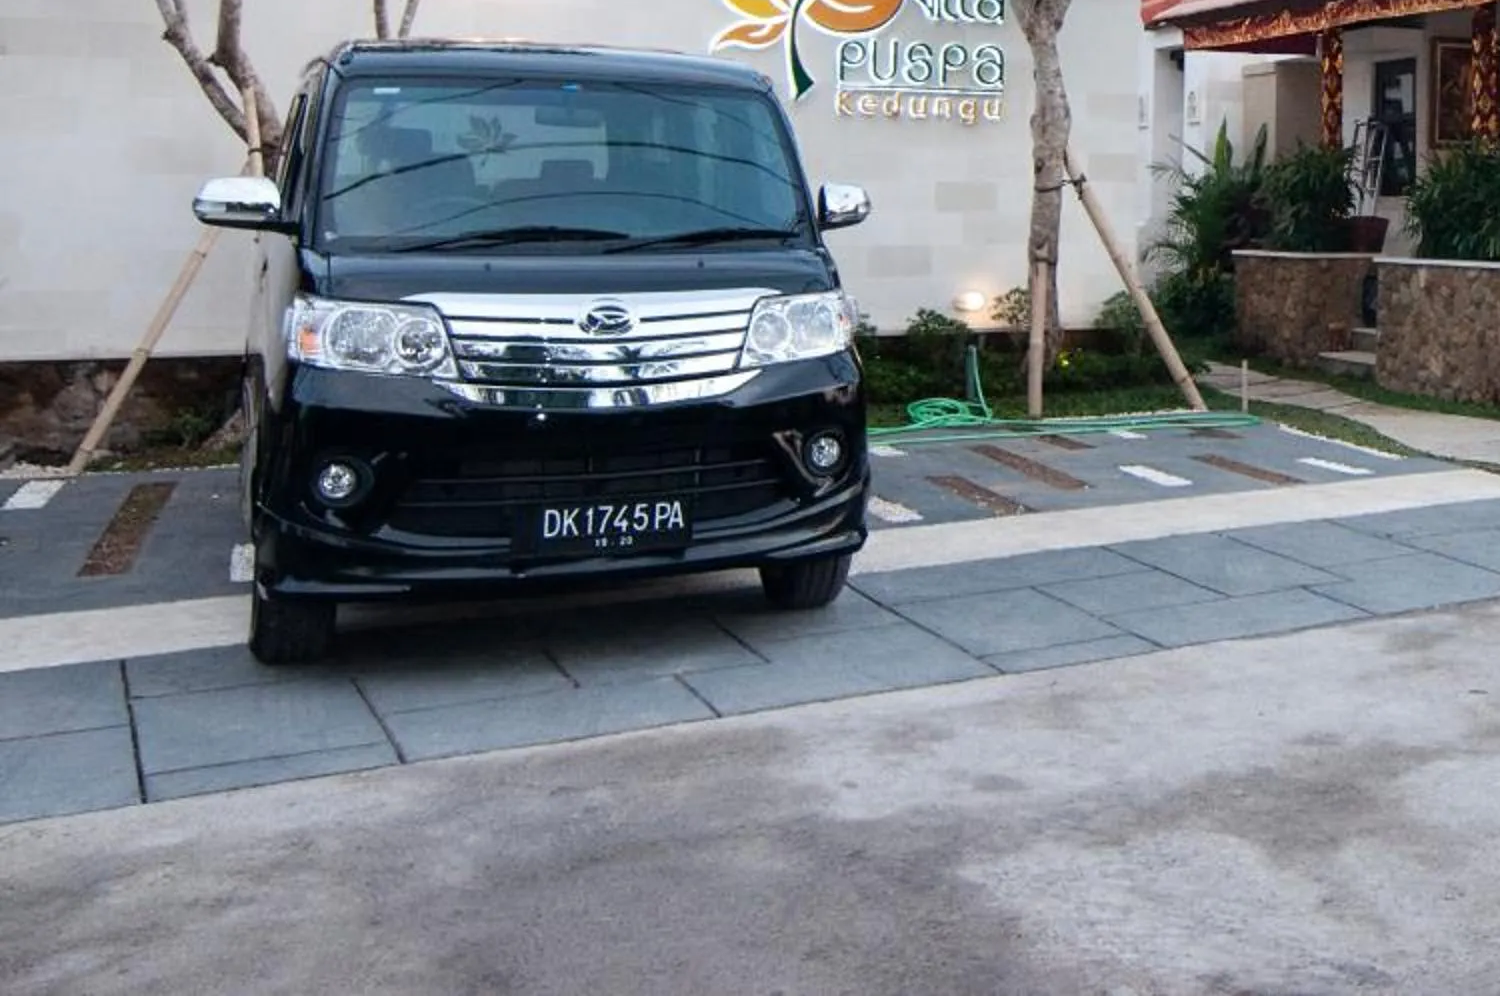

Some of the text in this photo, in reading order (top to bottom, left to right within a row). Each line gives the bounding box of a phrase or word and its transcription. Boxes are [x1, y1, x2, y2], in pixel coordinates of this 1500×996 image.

[543, 501, 684, 539] DK 1745 PA
